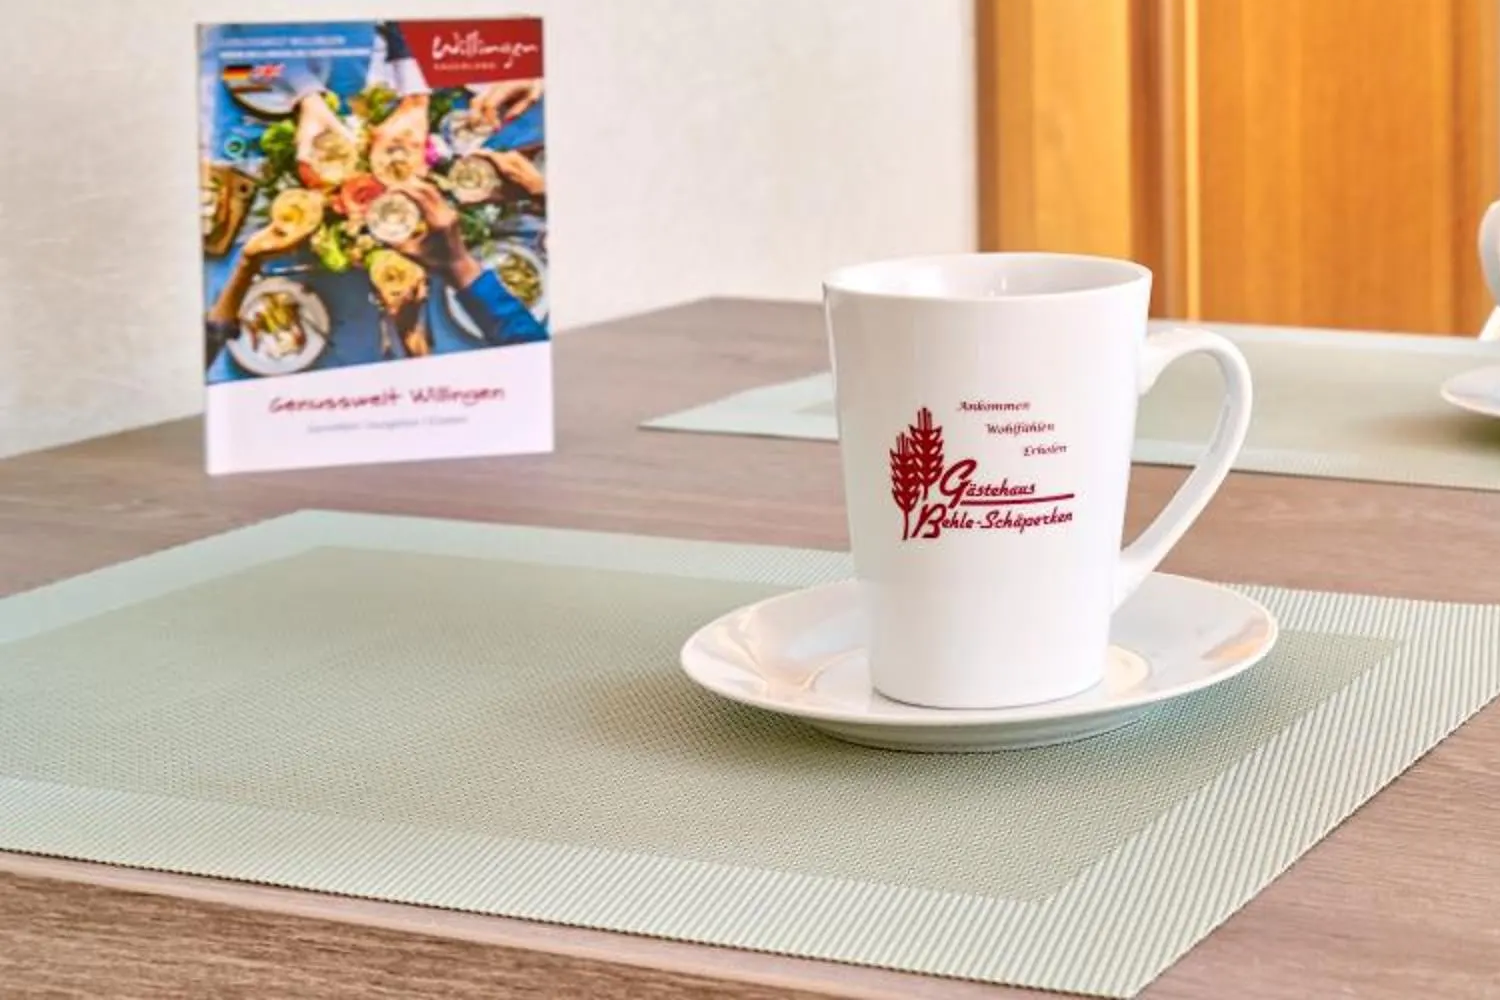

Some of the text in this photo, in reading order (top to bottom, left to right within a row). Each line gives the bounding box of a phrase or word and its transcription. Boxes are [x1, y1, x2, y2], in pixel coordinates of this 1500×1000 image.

[269, 387, 505, 413] Genusswelt Willingen
[956, 401, 1030, 412] Ankommen
[940, 459, 1036, 508] Gästehaus
[910, 504, 1073, 538] Behle-Schäperken
